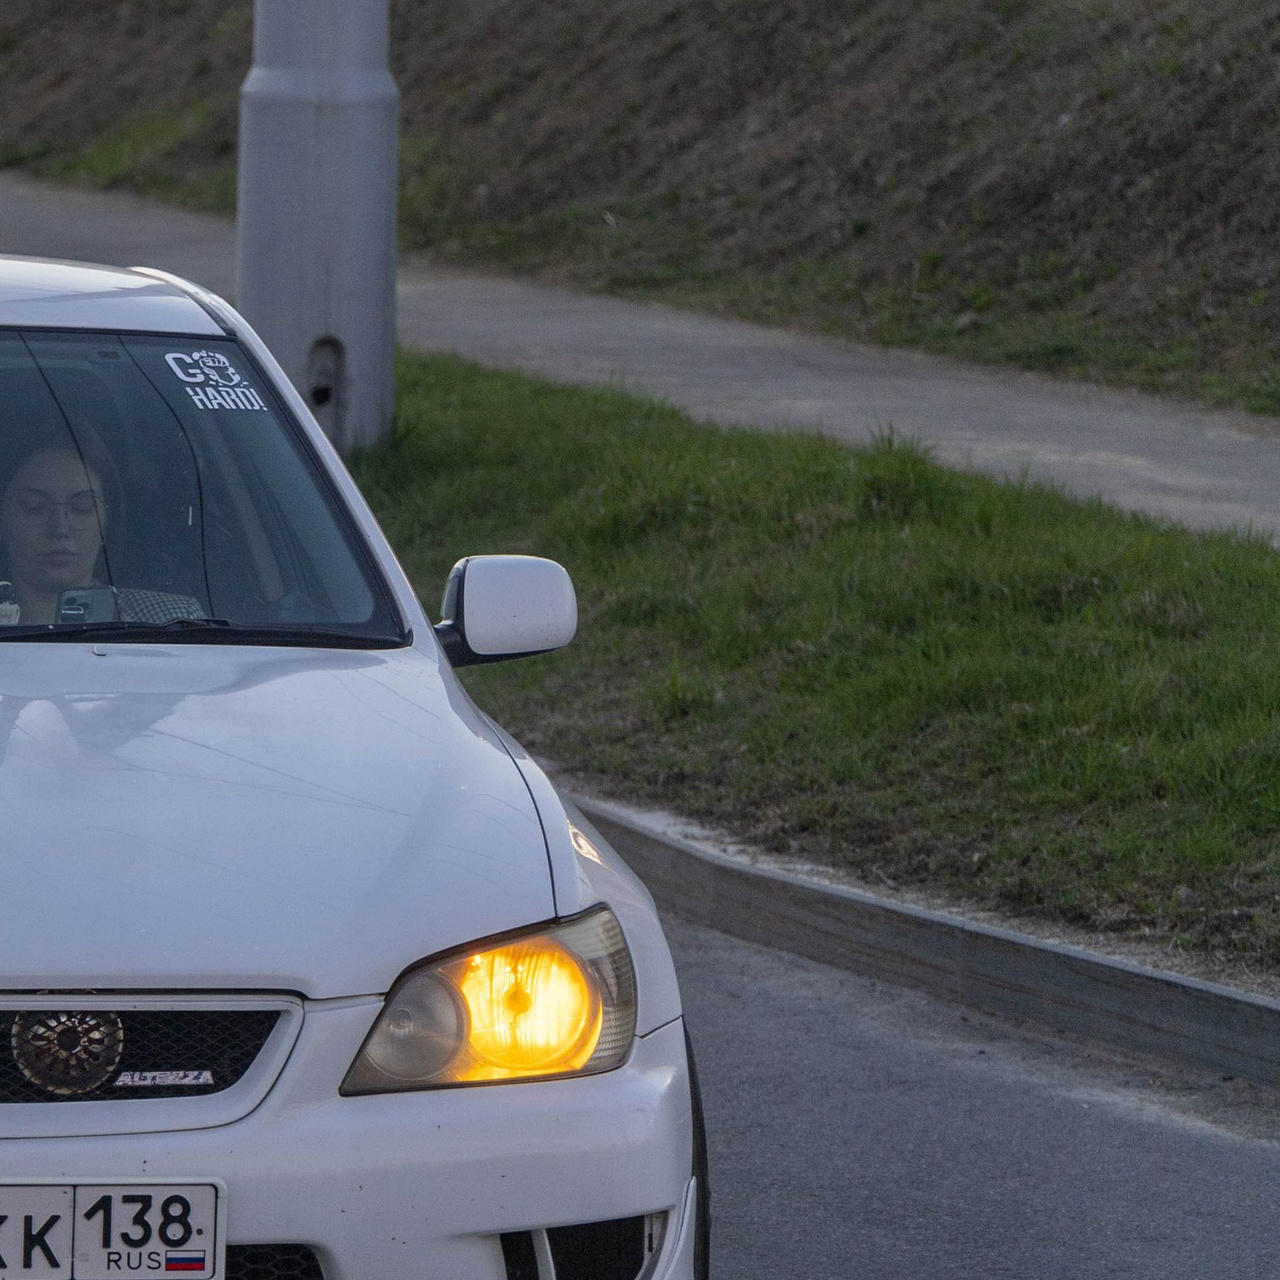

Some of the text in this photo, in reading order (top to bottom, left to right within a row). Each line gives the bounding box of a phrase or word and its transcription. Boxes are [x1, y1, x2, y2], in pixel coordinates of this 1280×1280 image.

[185, 387, 268, 411] HARD!
[113, 1071, 214, 1086] ALTEZZA
[83, 1194, 192, 1248] 138
[106, 1251, 161, 1271] RUS
